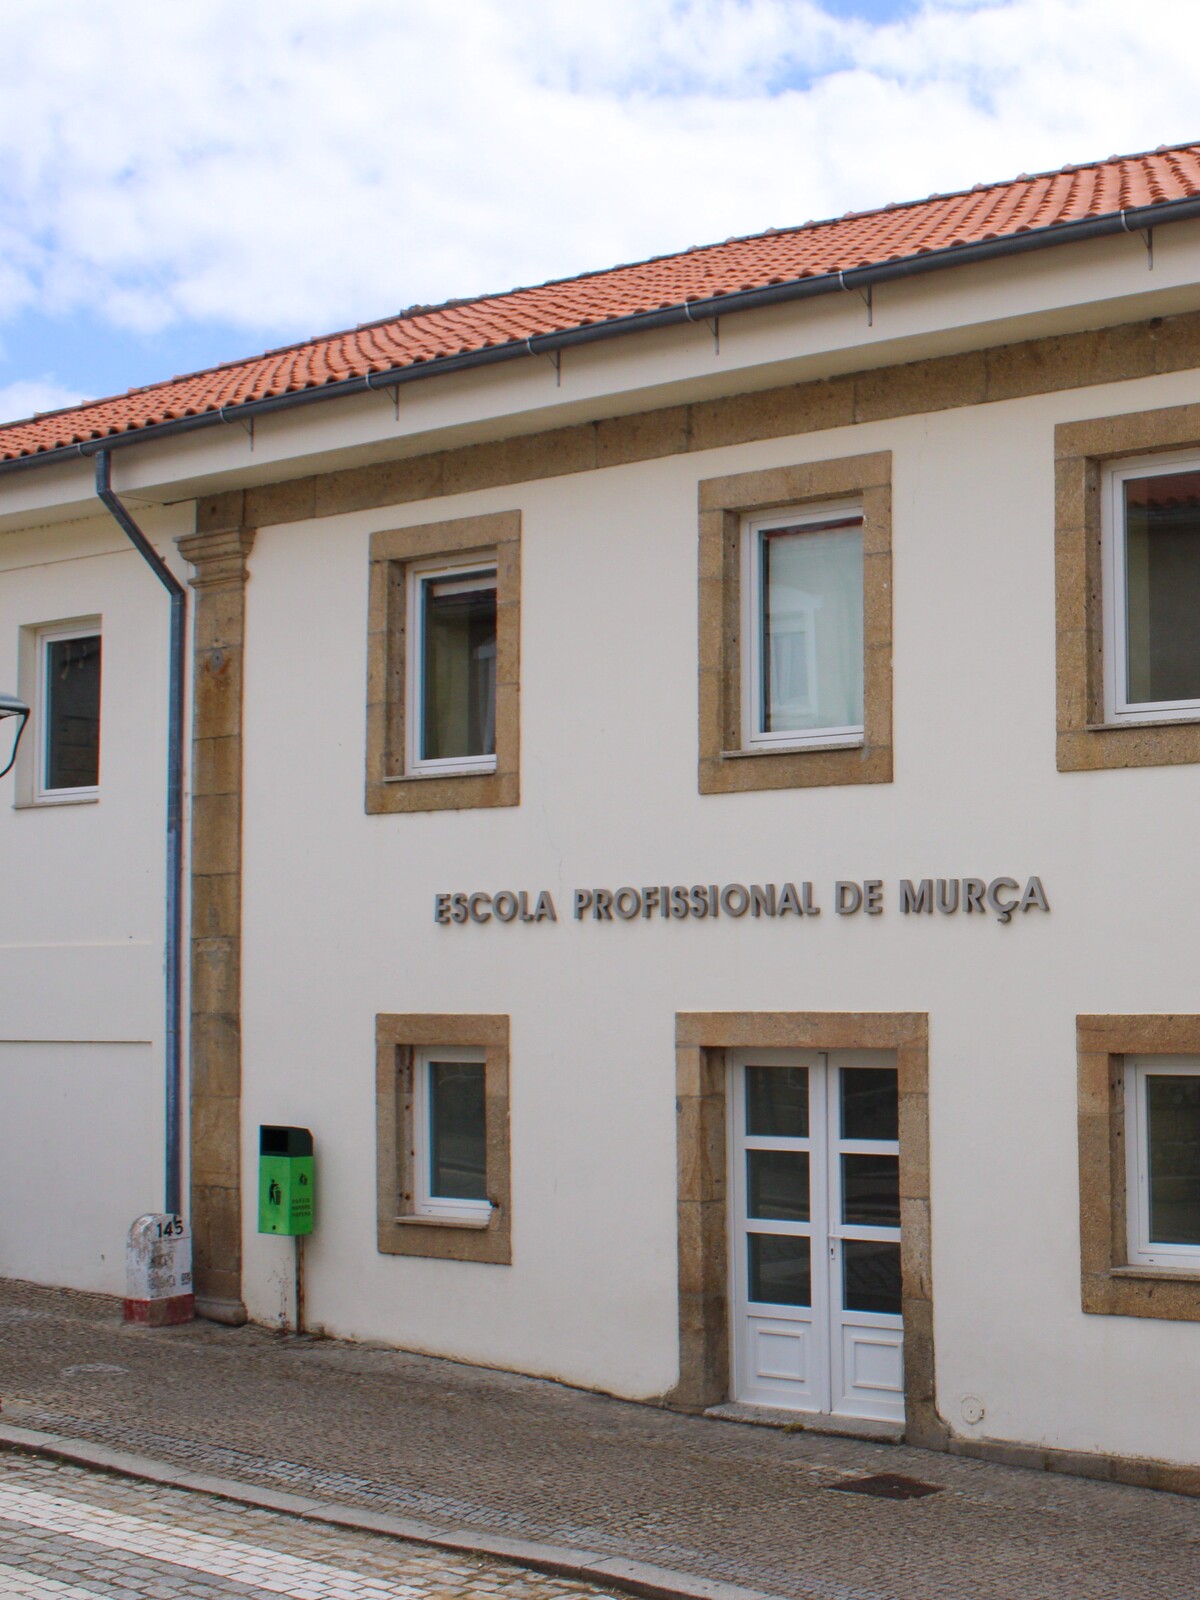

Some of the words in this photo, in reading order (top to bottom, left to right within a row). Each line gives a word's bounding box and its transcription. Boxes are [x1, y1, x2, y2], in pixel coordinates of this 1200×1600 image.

[434, 890, 557, 924] ESCOLA
[573, 880, 821, 921] PROFISSIONAL
[835, 878, 884, 917] DE
[900, 875, 1050, 924] MURÇA
[157, 1219, 183, 1238] 145
